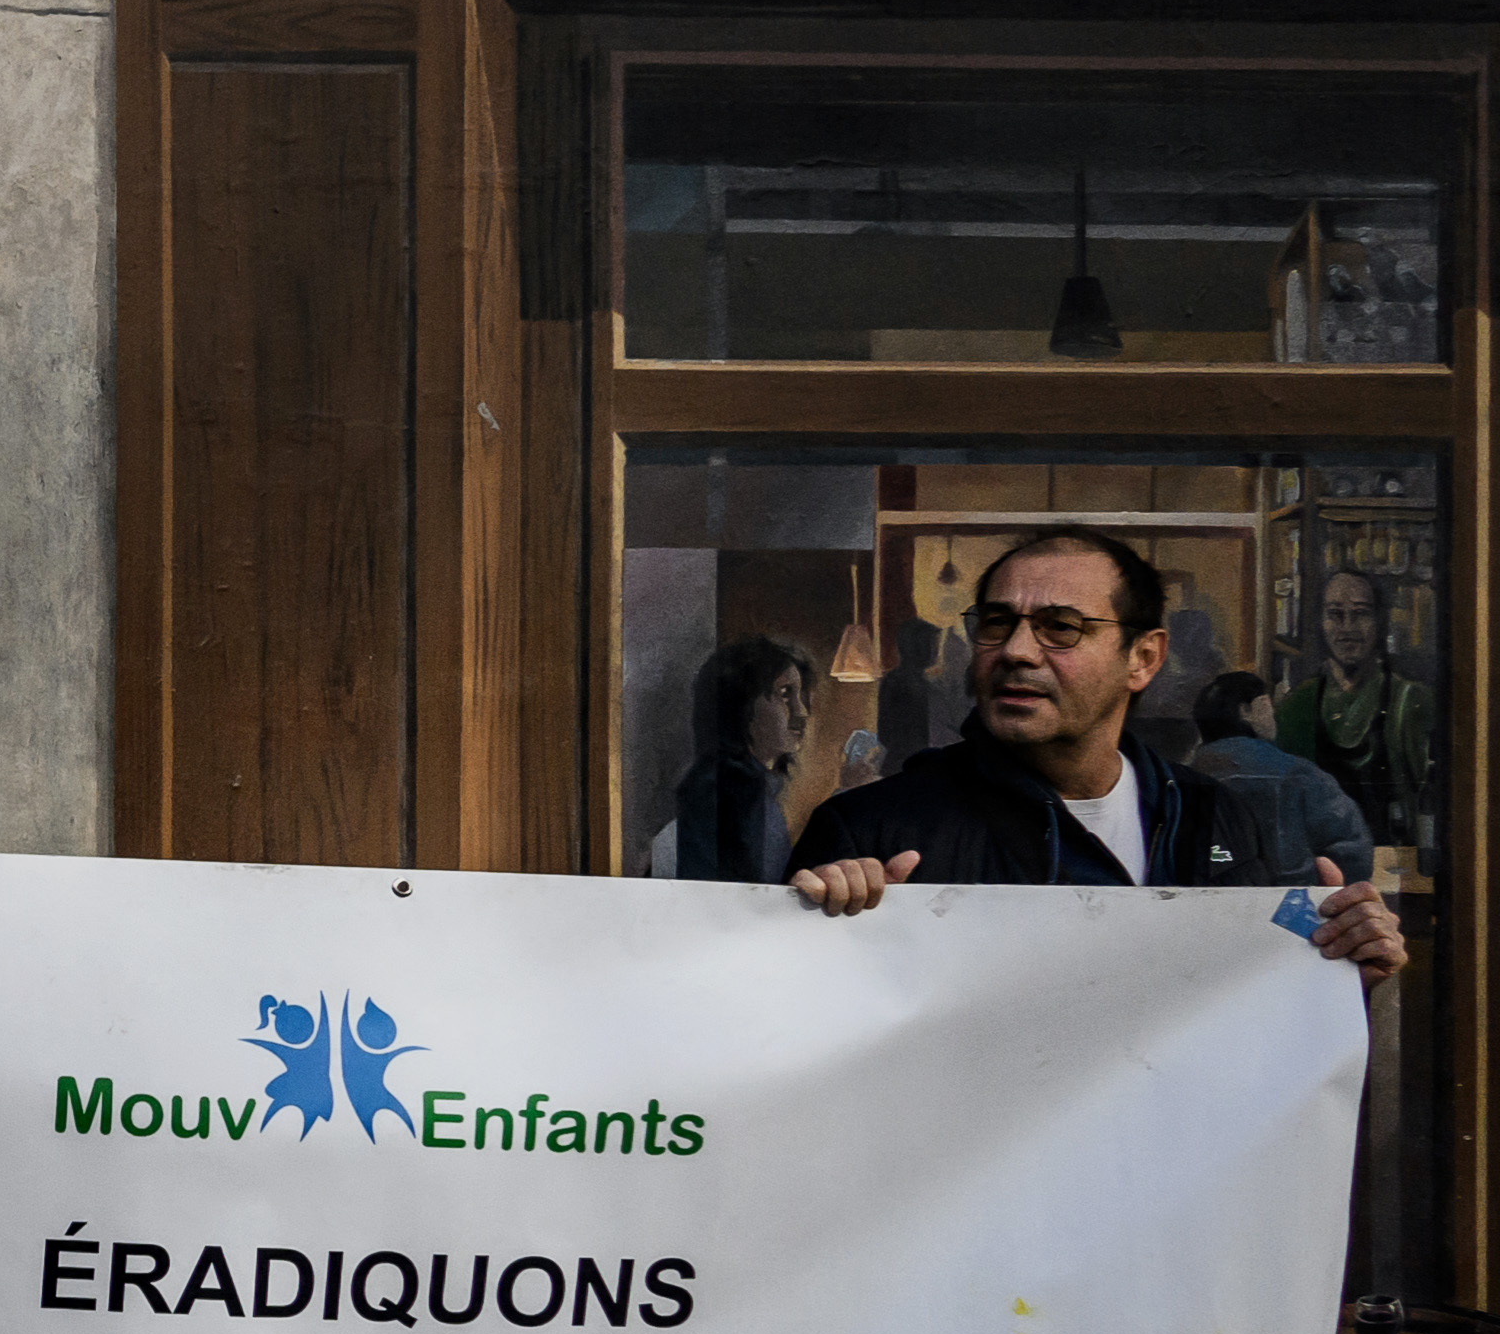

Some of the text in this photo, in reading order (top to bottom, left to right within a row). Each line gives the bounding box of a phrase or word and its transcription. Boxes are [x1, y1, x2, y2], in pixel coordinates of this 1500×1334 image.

[56, 1076, 704, 1155] Mouv Enfants
[41, 1222, 695, 1328] ÉRADIQUONS
